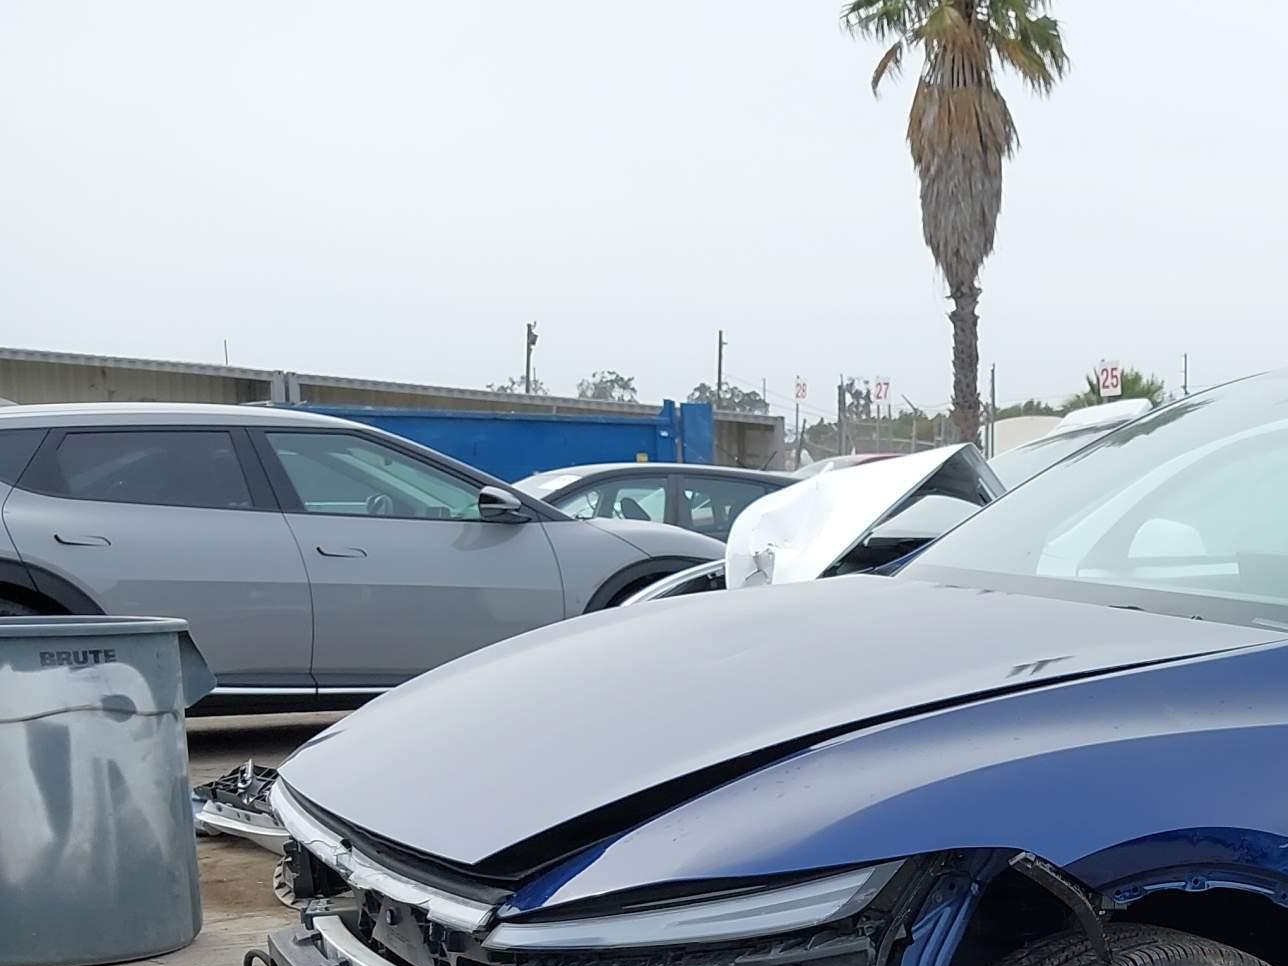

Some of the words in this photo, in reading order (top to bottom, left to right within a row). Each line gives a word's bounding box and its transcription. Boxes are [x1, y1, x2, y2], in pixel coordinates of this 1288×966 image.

[1100, 367, 1119, 389] 25
[875, 382, 890, 400] 27
[39, 649, 117, 666] BRUTE
